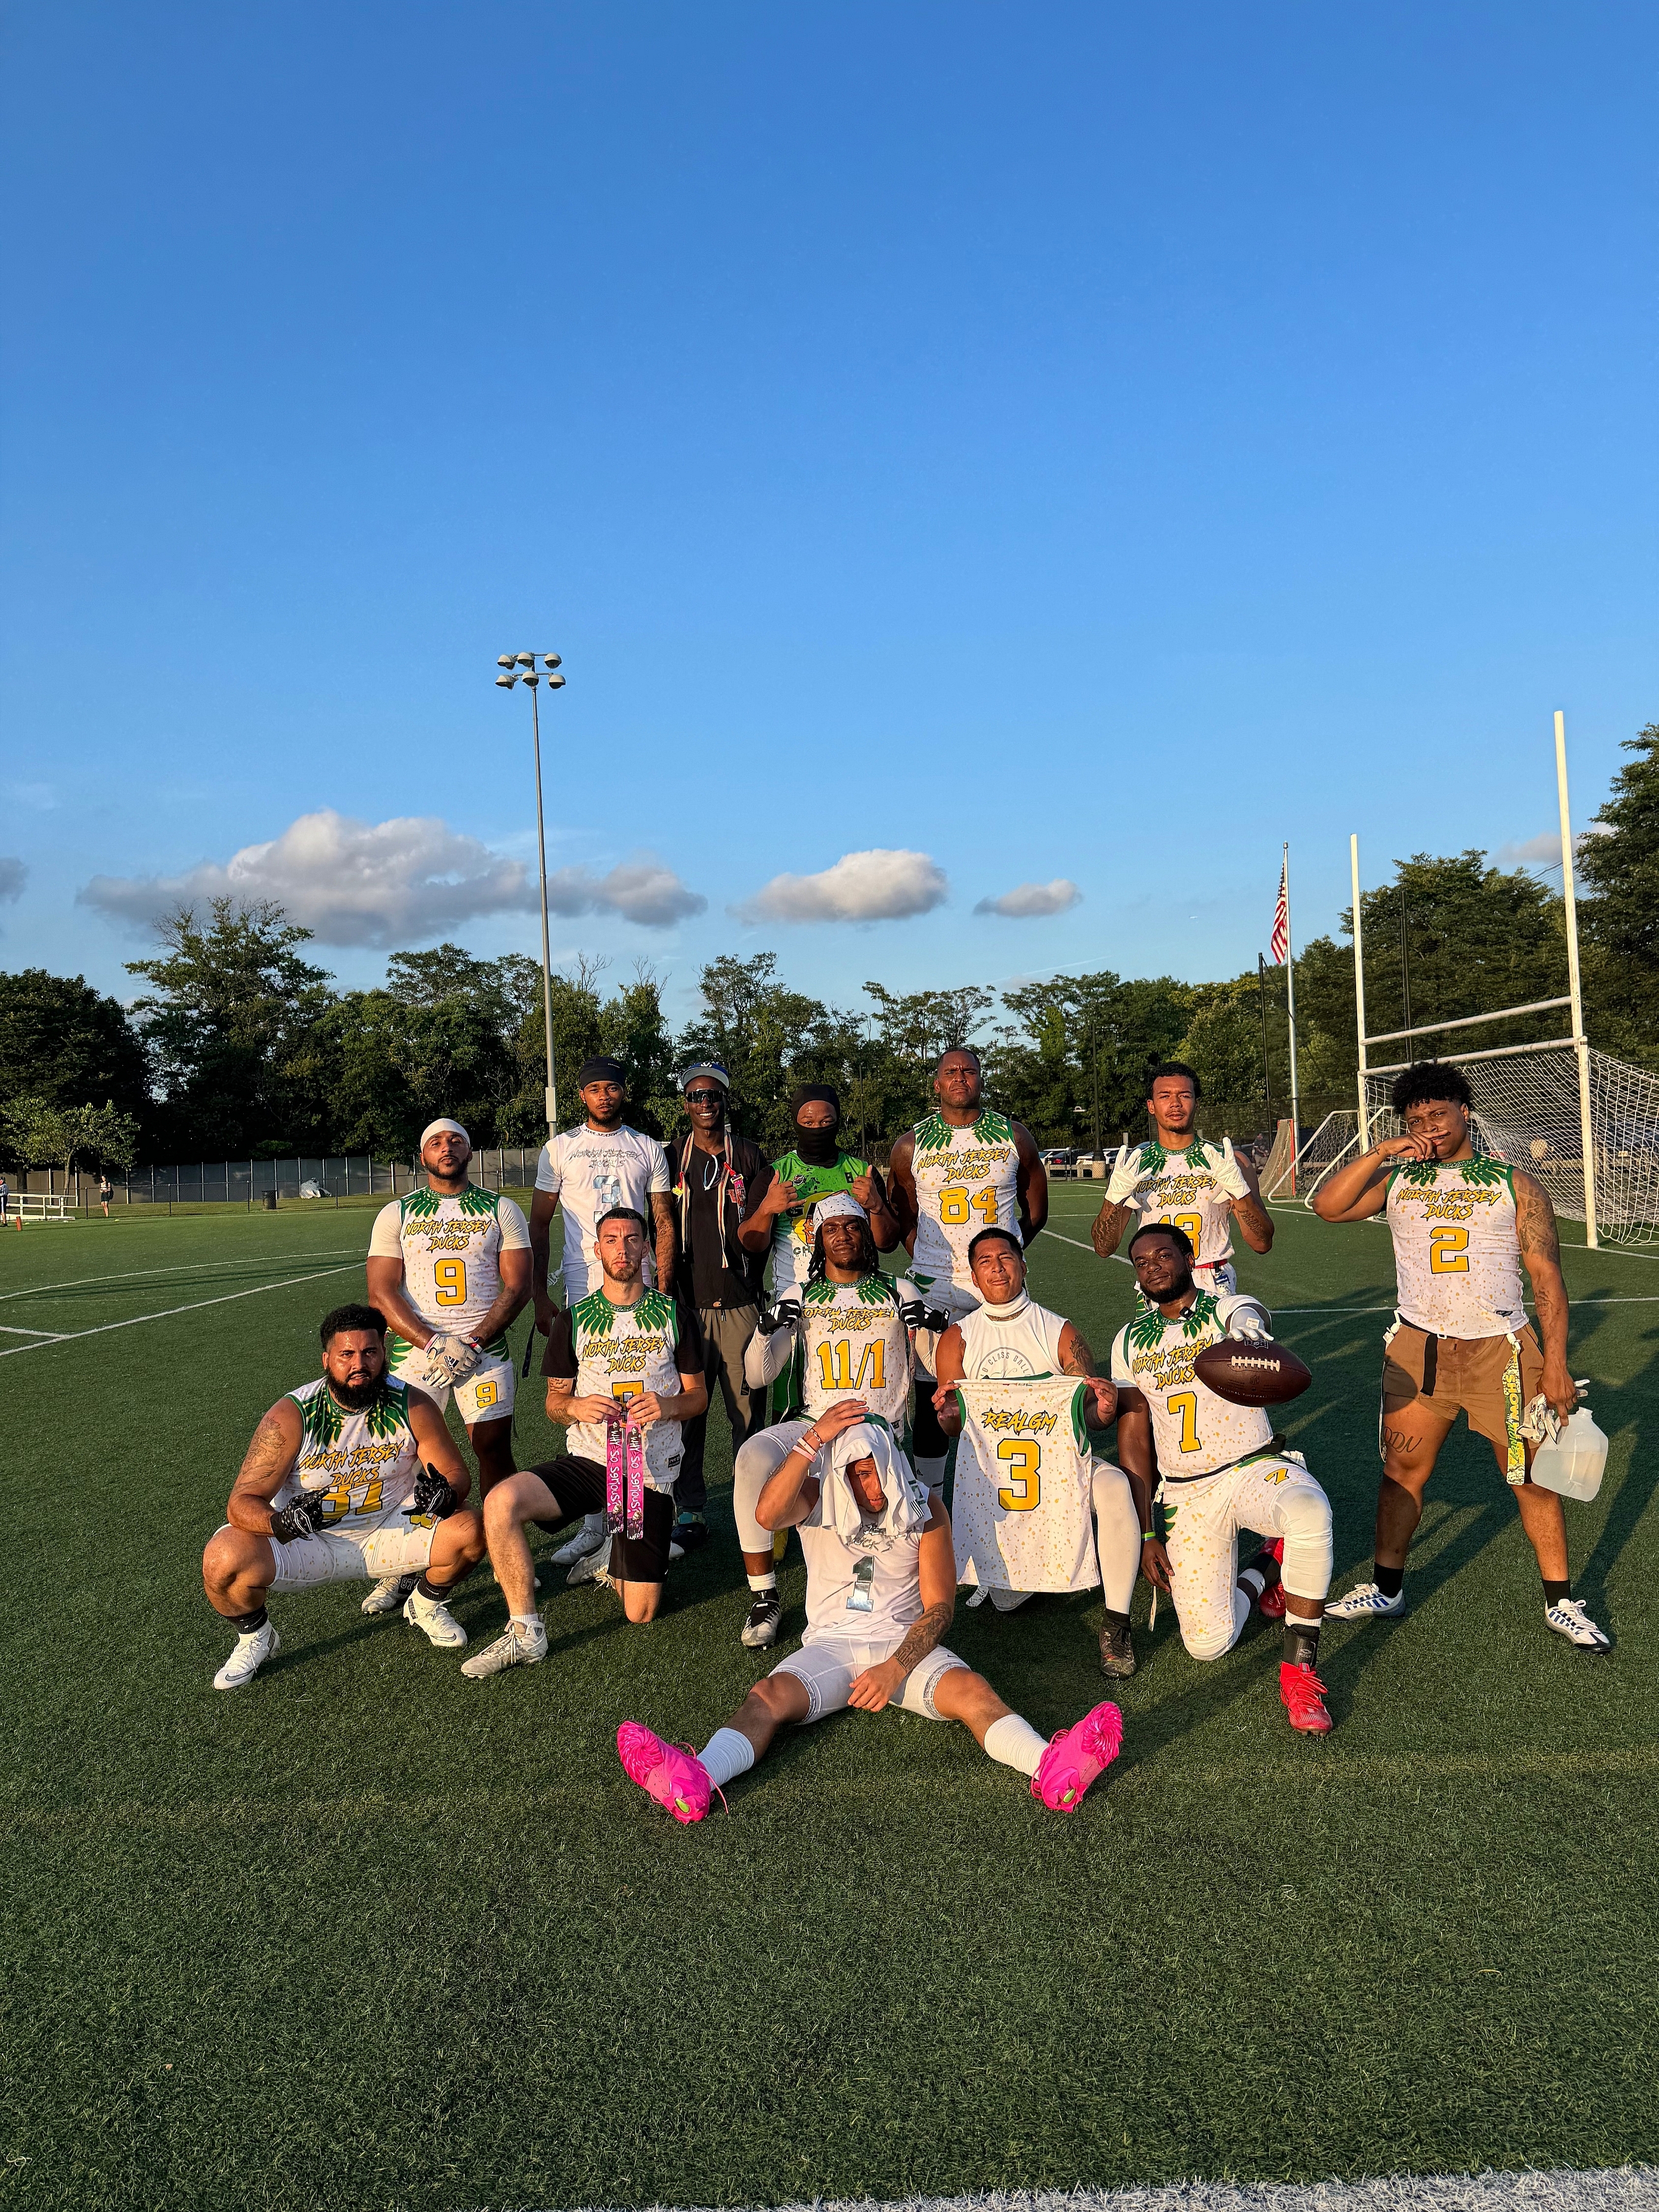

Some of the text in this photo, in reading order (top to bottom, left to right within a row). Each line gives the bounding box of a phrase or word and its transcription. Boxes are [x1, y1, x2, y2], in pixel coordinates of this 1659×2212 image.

[917, 1147, 1011, 1174] NORTH JERSEY
[942, 1163, 990, 1184] DUCKS
[1133, 1173, 1218, 1197] NORTH JERSEY
[1395, 1188, 1502, 1206] NORTH JERSEY
[938, 1185, 999, 1225] 84
[1156, 1190, 1197, 1210] DUCKS
[1420, 1204, 1474, 1221] DUCKS
[404, 1218, 492, 1240] NORTH JERSEY
[426, 1235, 470, 1253] DUCKS
[1429, 1226, 1469, 1274] 2
[434, 1258, 467, 1307] 9
[827, 1315, 873, 1335] DUCKS
[582, 1334, 667, 1361] NORTH JERSEY
[604, 1355, 647, 1376] DUCKS
[816, 1339, 886, 1390] 11/1
[1132, 1349, 1165, 1378] NORTH
[1153, 1363, 1196, 1392] DUCKS
[475, 1380, 498, 1408] 9
[1505, 1374, 1519, 1422] SHOW
[981, 1407, 1058, 1436] REALGM
[1166, 1391, 1202, 1454] 7
[296, 1439, 406, 1472] NORTH JERSEY
[328, 1466, 380, 1488] DUCKS
[997, 1438, 1041, 1512] 3
[1264, 1467, 1290, 1485] 7
[400, 1576, 414, 1591] 87
[845, 1555, 875, 1613] 1
